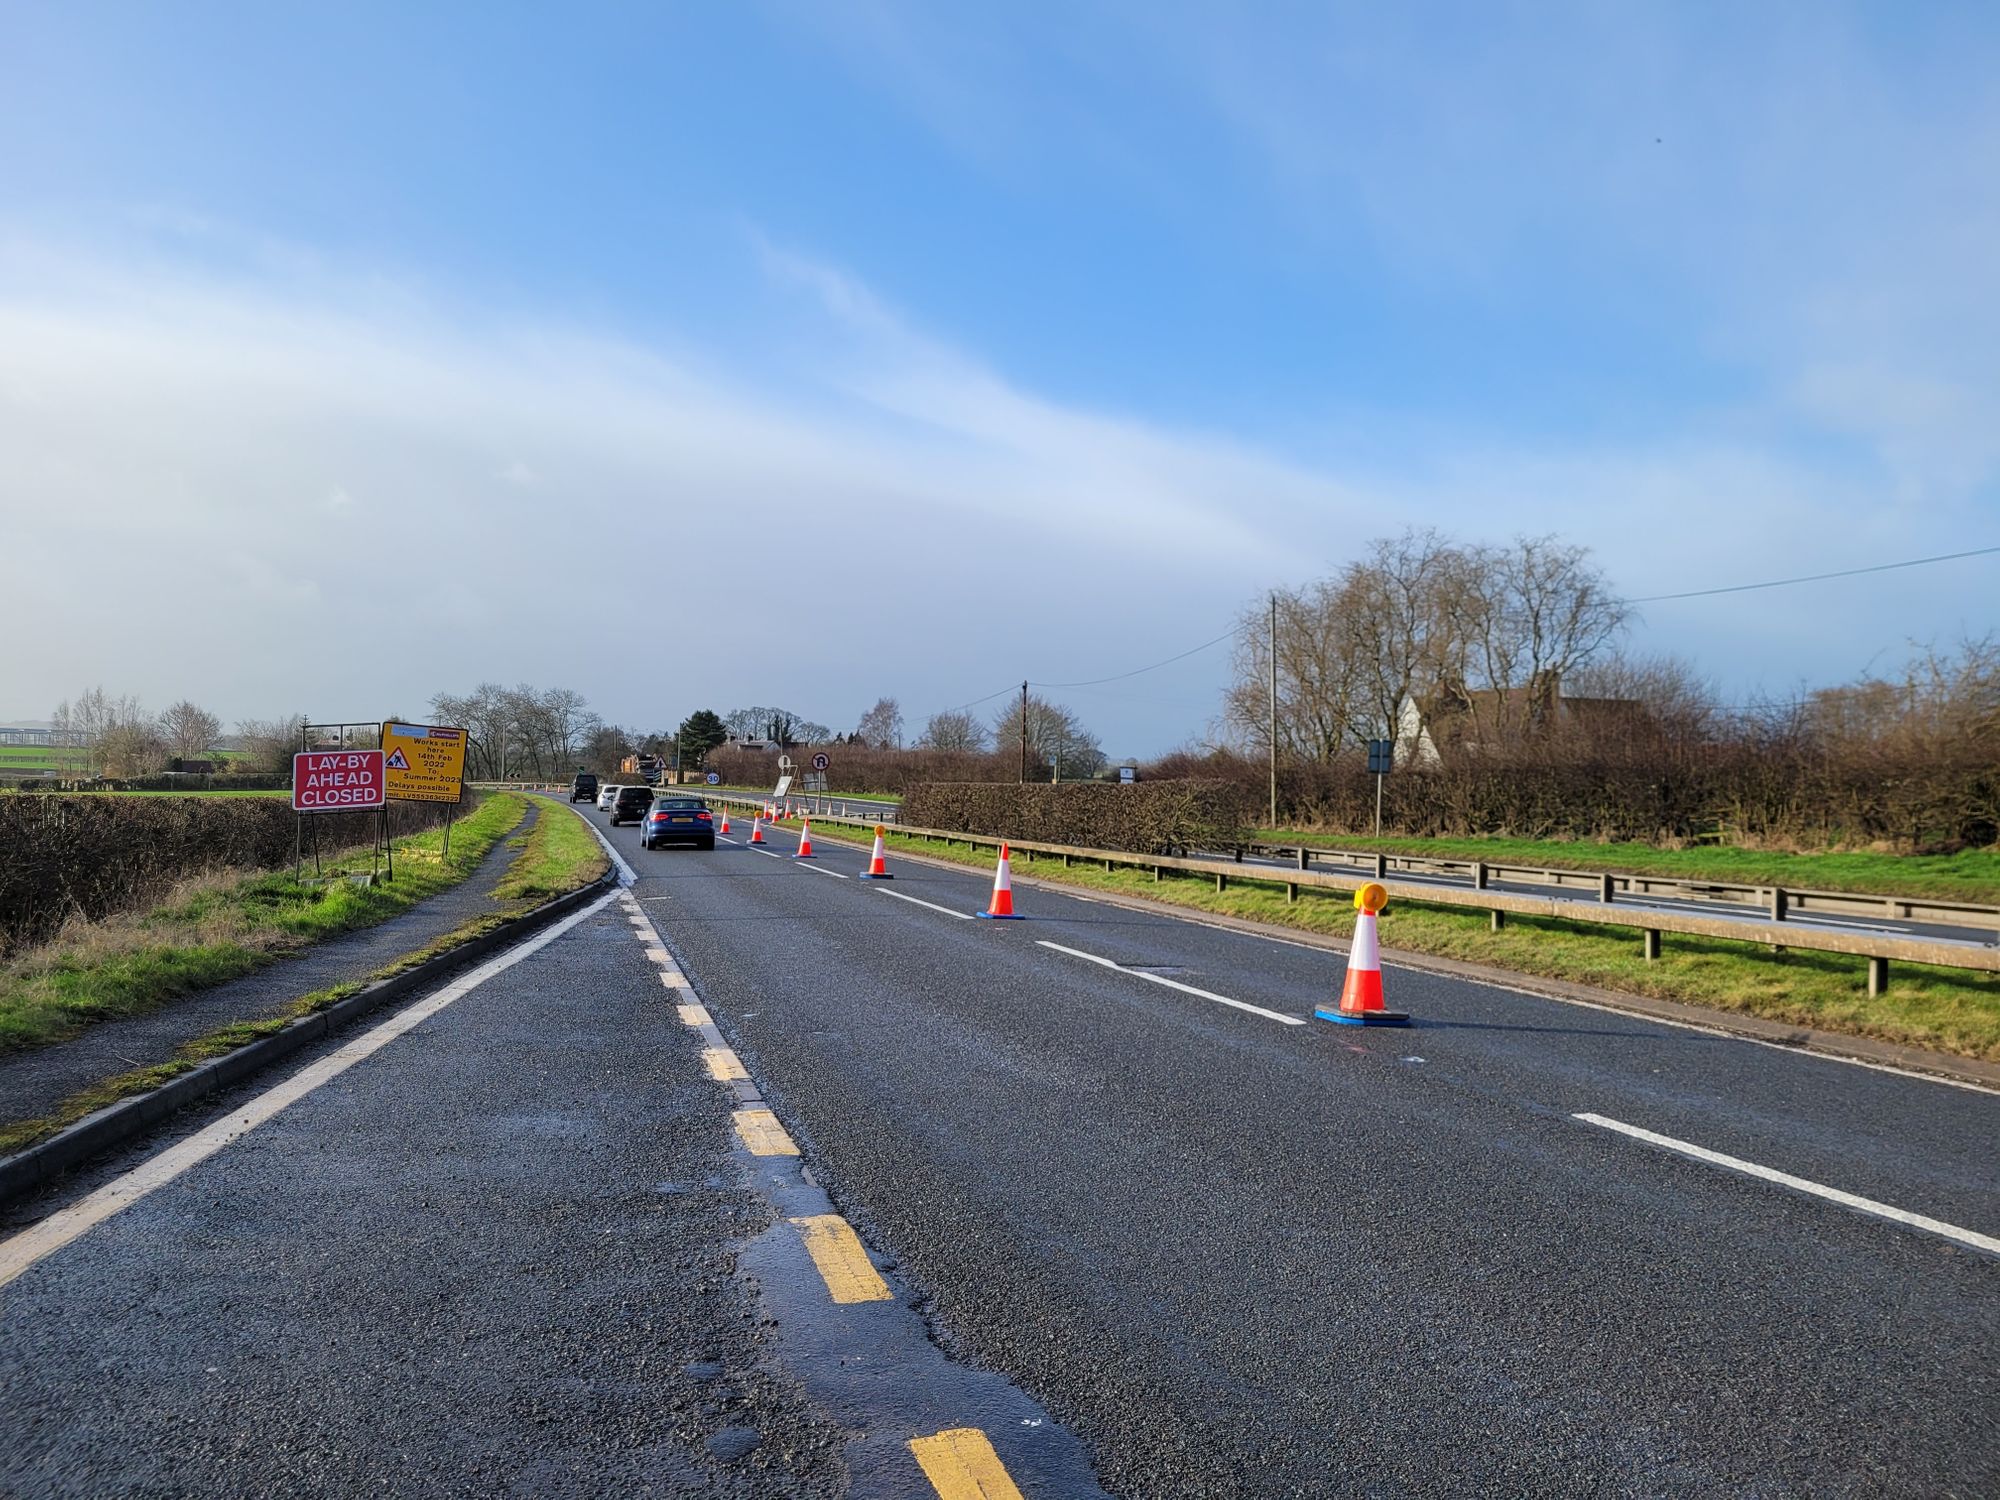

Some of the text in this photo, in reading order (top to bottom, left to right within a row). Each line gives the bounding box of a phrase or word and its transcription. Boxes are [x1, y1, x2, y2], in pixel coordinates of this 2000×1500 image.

[441, 740, 460, 748] start
[308, 754, 370, 771] LAY-BY
[307, 771, 373, 788] AHEAD
[403, 773, 461, 783] Summer 2023
[388, 781, 415, 789] Delays
[301, 788, 377, 805] CLOSED
